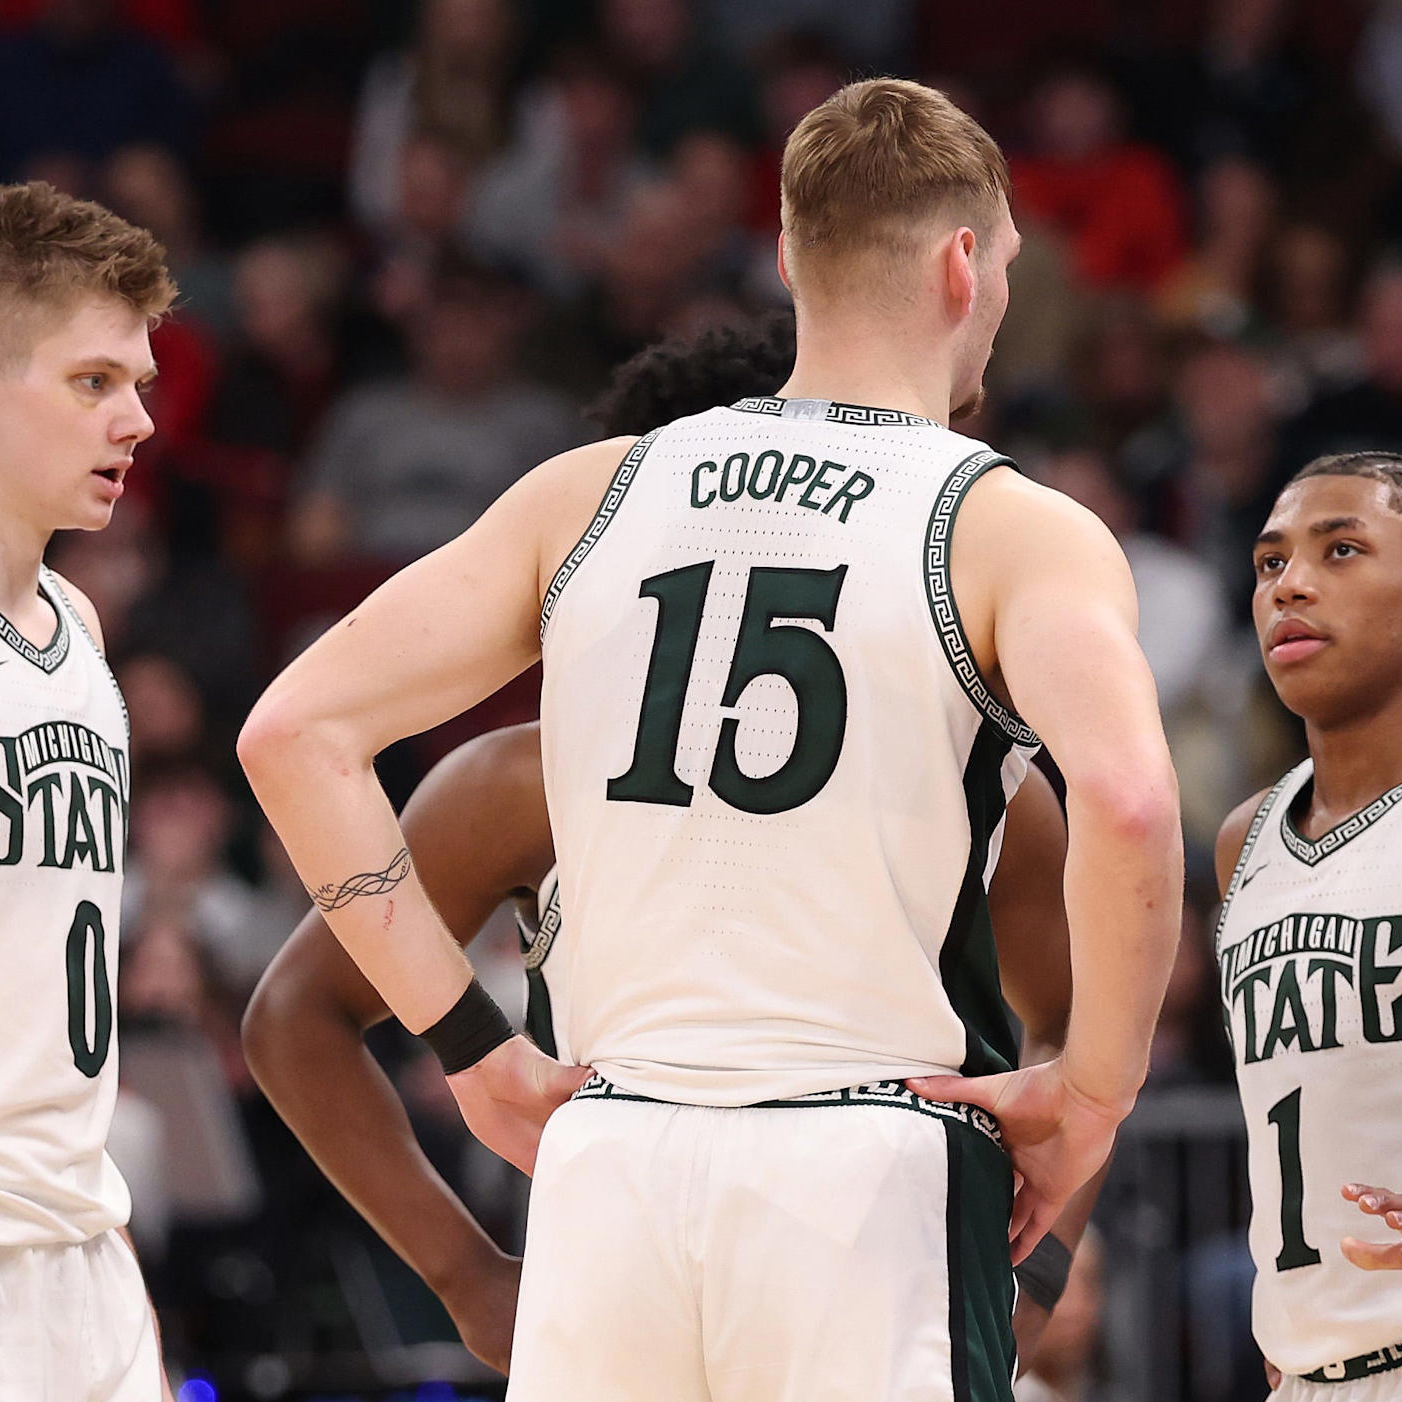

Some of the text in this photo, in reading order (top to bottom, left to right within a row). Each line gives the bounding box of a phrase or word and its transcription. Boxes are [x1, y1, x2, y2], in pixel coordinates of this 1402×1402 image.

[691, 450, 875, 523] COOPER
[607, 560, 848, 815] 15
[66, 900, 112, 1079] 0
[1234, 915, 1357, 976] MICHIGAN
[1267, 1086, 1321, 1272] 1
